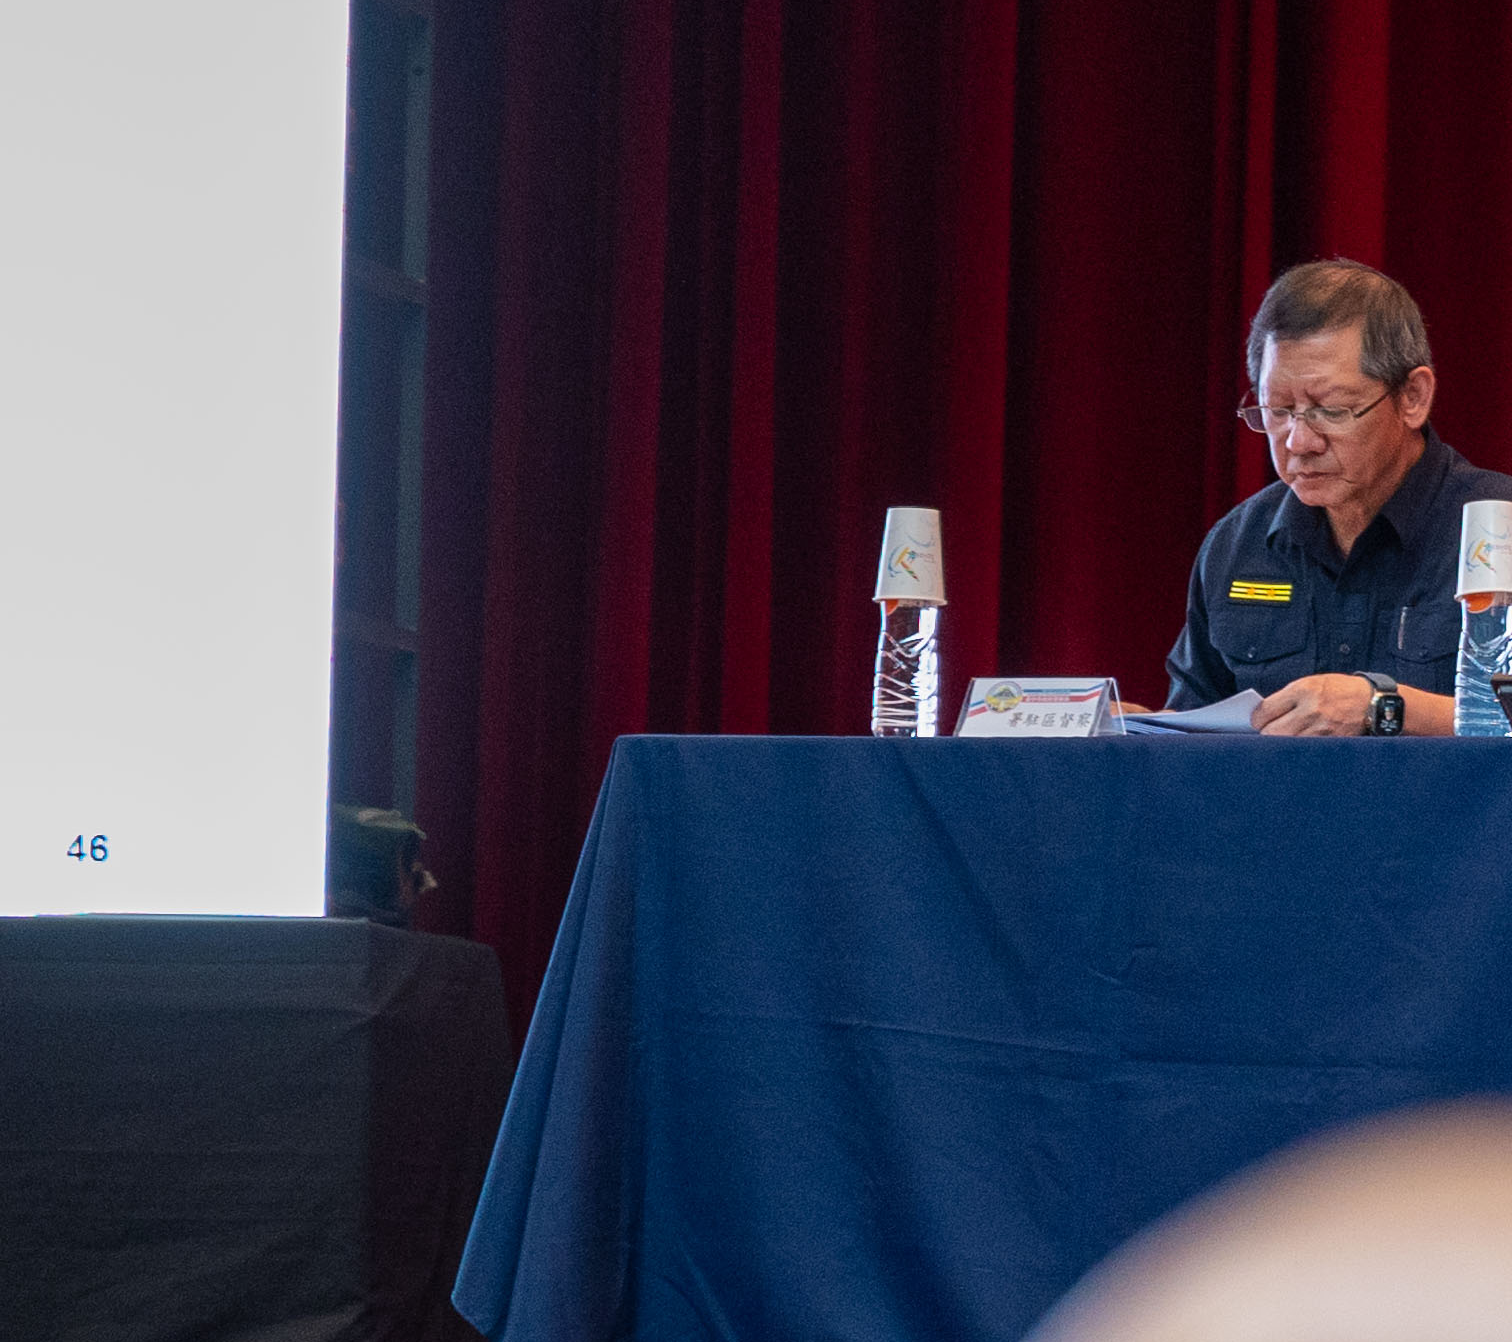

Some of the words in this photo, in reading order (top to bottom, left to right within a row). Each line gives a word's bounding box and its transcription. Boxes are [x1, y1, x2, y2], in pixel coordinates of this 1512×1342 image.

[1008, 712, 1092, 728] 署駐區督察
[66, 834, 108, 862] 46
